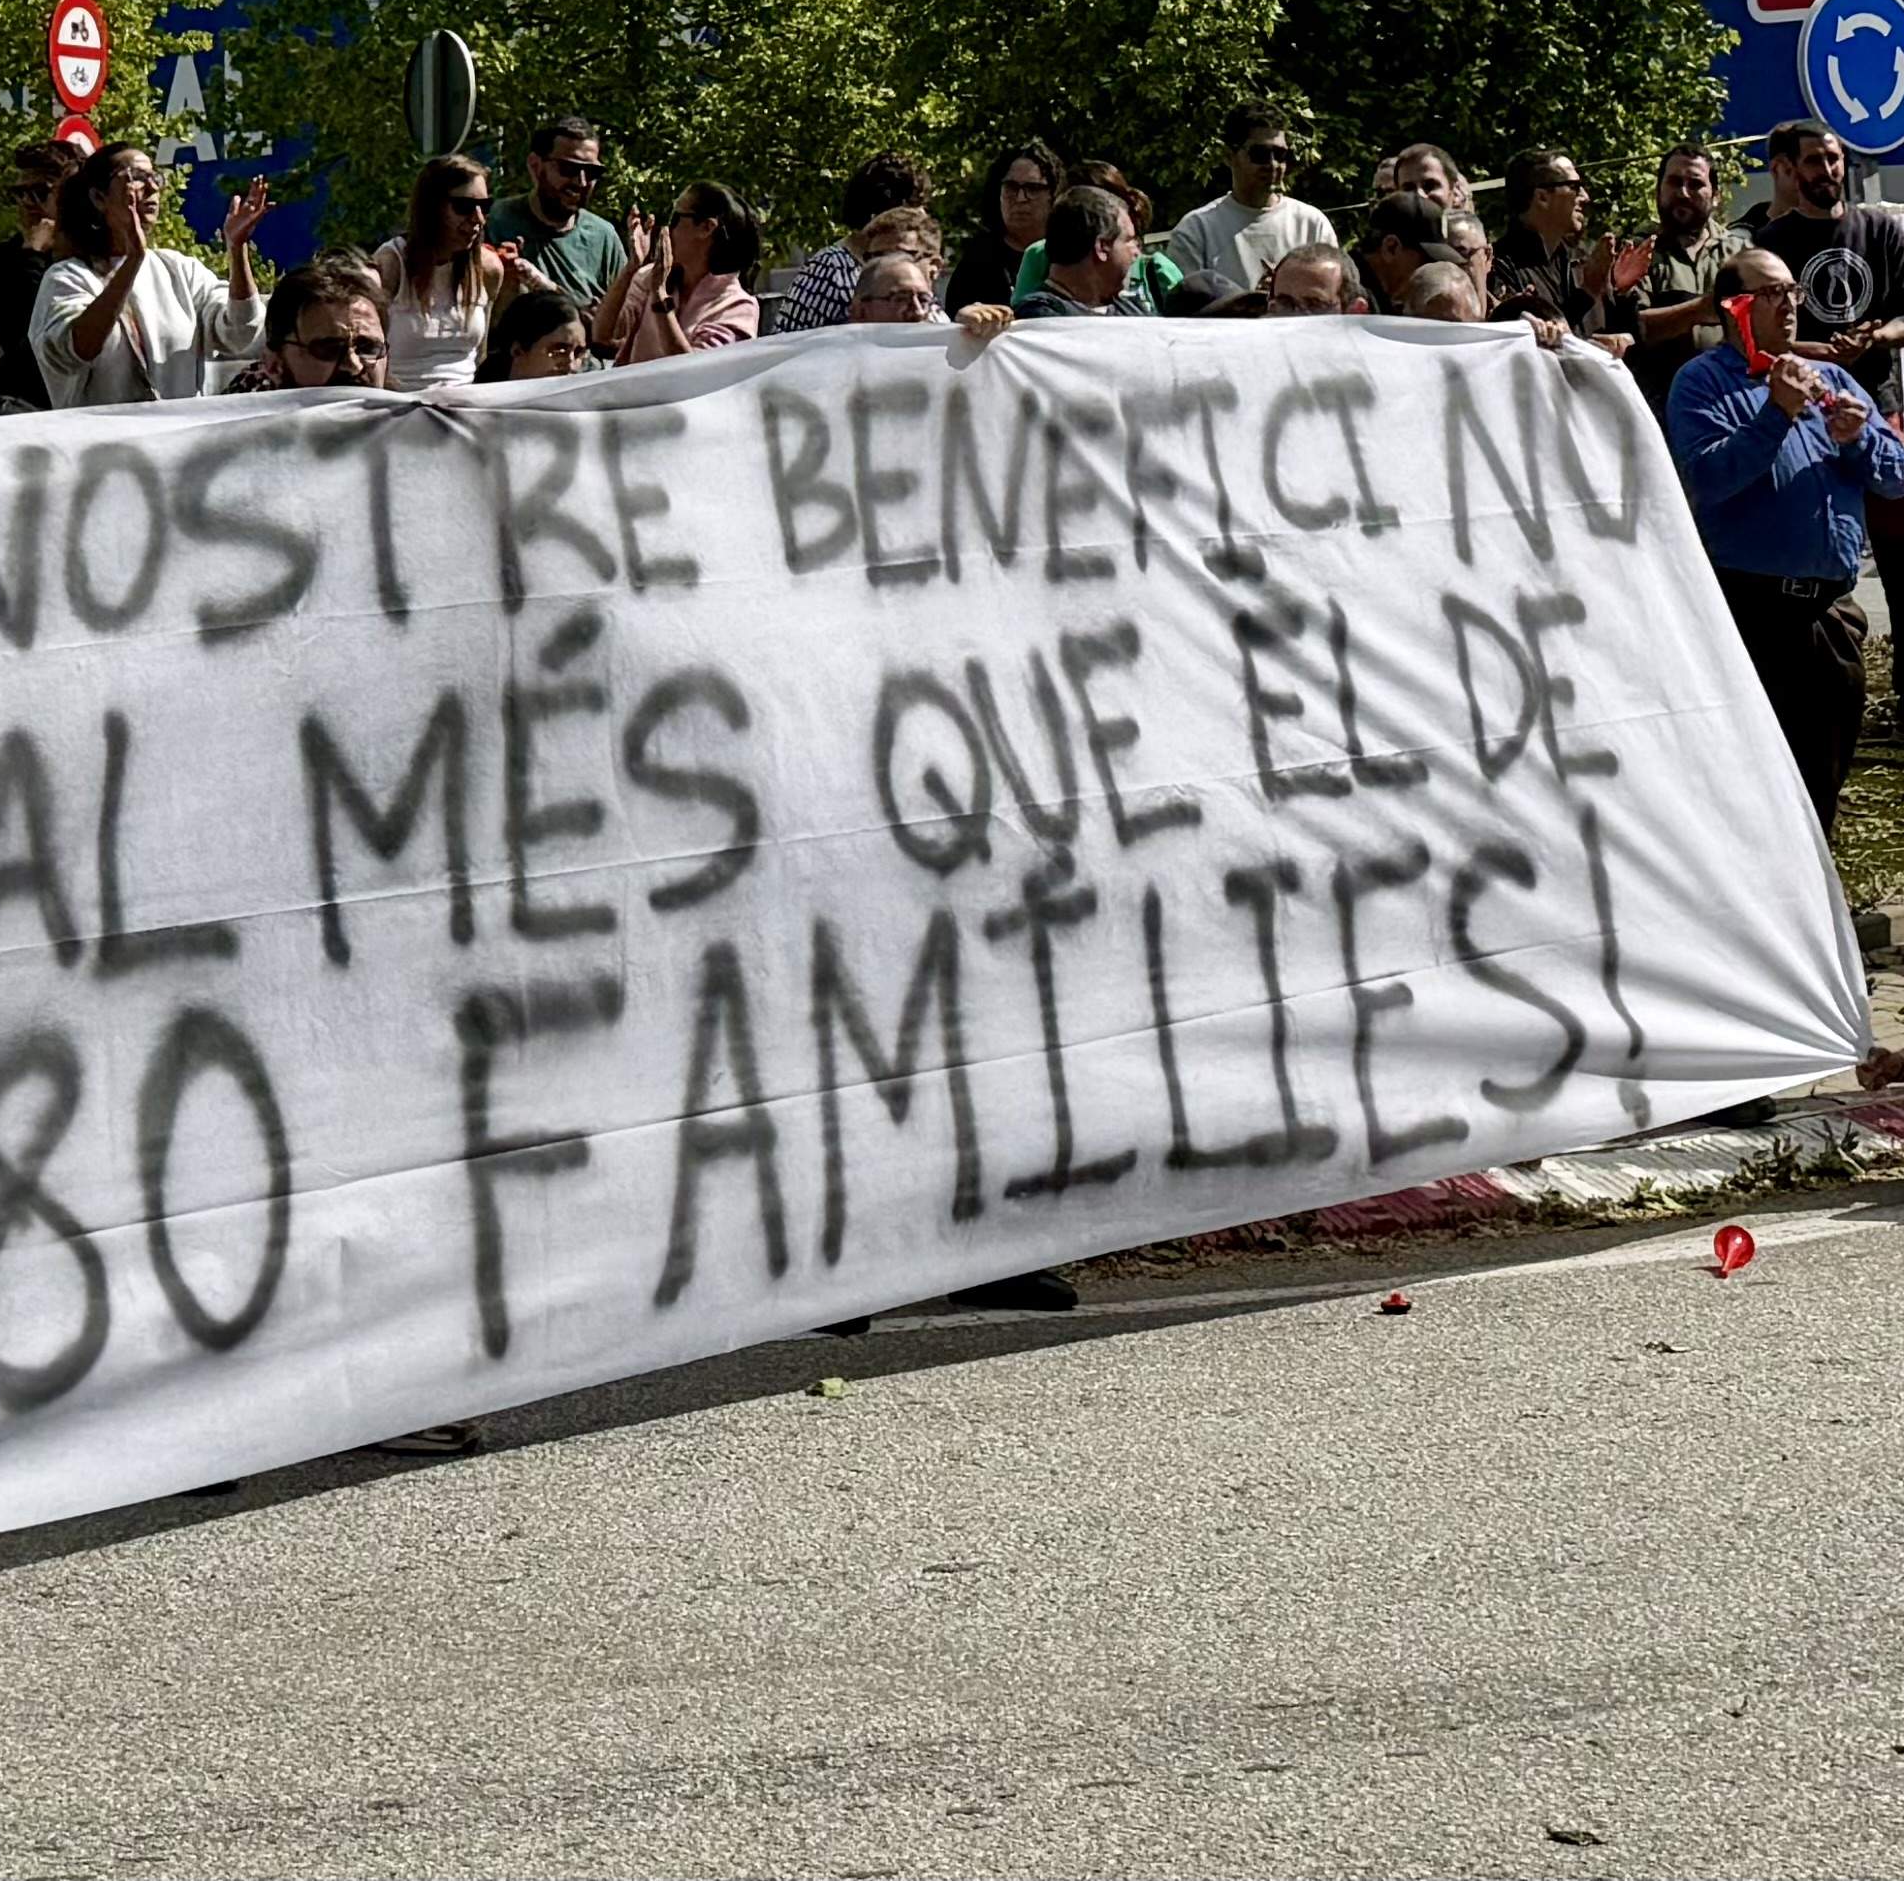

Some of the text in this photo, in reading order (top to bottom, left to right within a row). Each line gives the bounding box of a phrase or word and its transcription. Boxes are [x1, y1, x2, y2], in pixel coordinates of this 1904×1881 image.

[758, 371, 1400, 590] BENEFICI
[1442, 353, 1647, 564] NO
[304, 610, 760, 967] MÉS
[870, 617, 1204, 877] QUE
[1229, 593, 1432, 800] EL
[1441, 590, 1620, 787] DE
